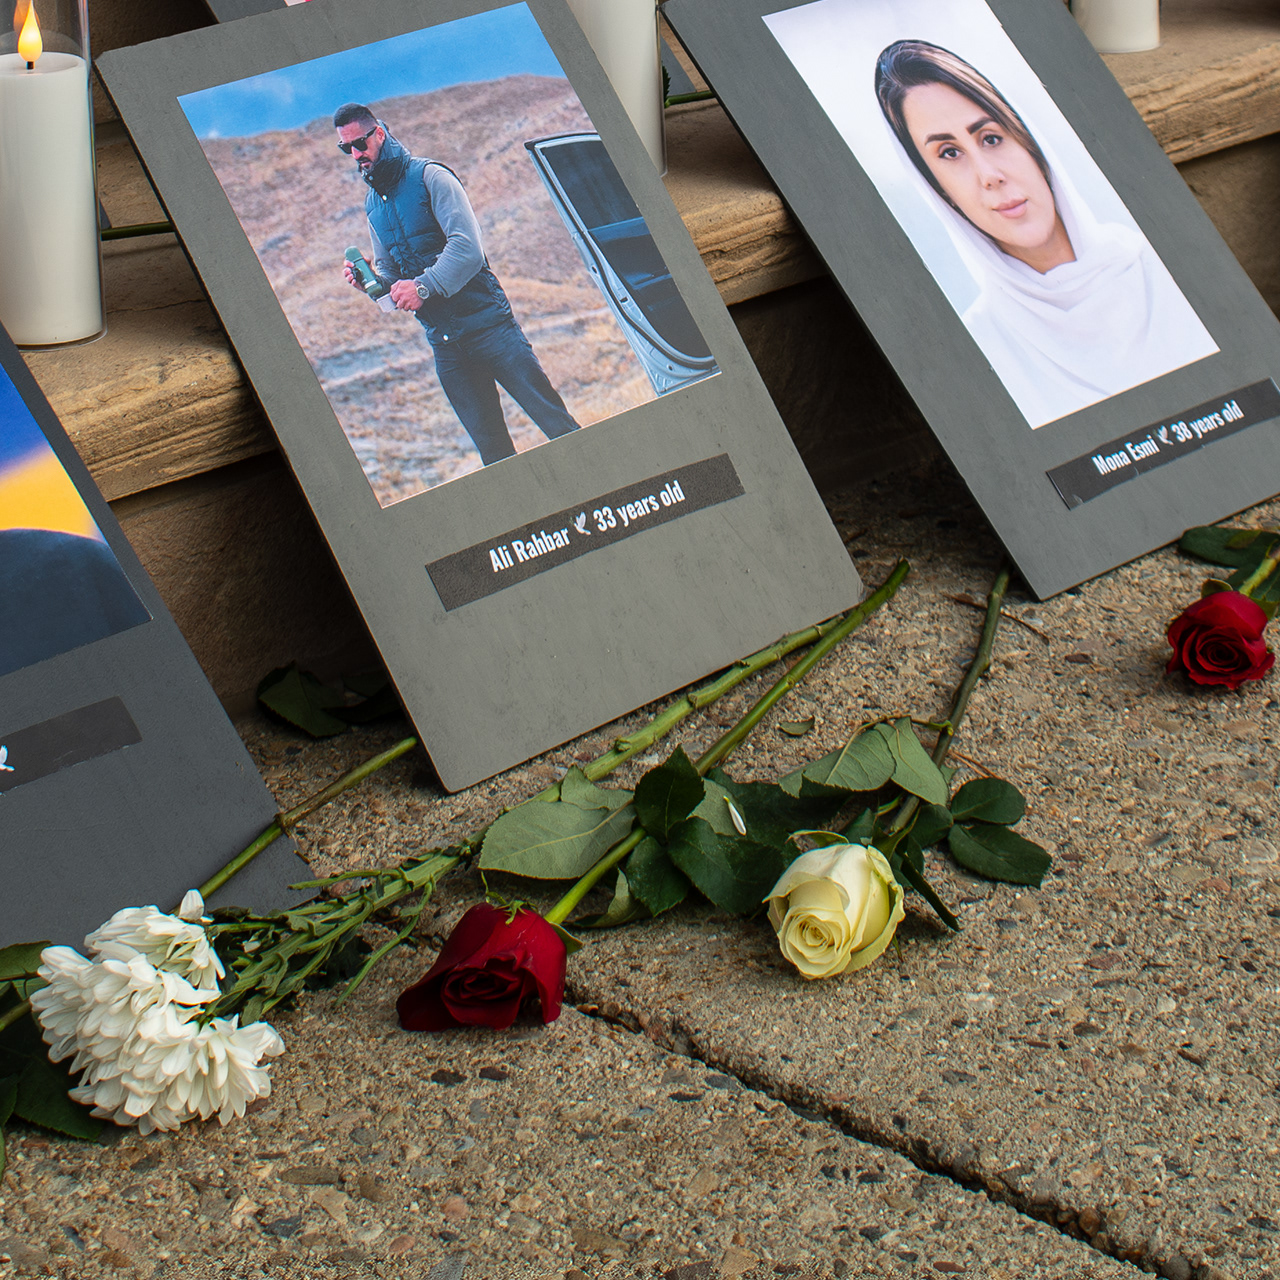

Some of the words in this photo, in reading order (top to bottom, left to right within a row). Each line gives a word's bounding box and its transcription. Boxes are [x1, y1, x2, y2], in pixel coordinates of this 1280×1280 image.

[1091, 448, 1132, 476] Mona
[1124, 433, 1160, 462] Esmi
[1170, 420, 1194, 443] 38
[1189, 410, 1225, 439] years
[1220, 399, 1245, 421] old
[488, 544, 515, 573] Ali
[512, 527, 570, 563] Rahbar
[593, 506, 617, 532] 33
[616, 494, 660, 528] years
[659, 479, 686, 507] old
